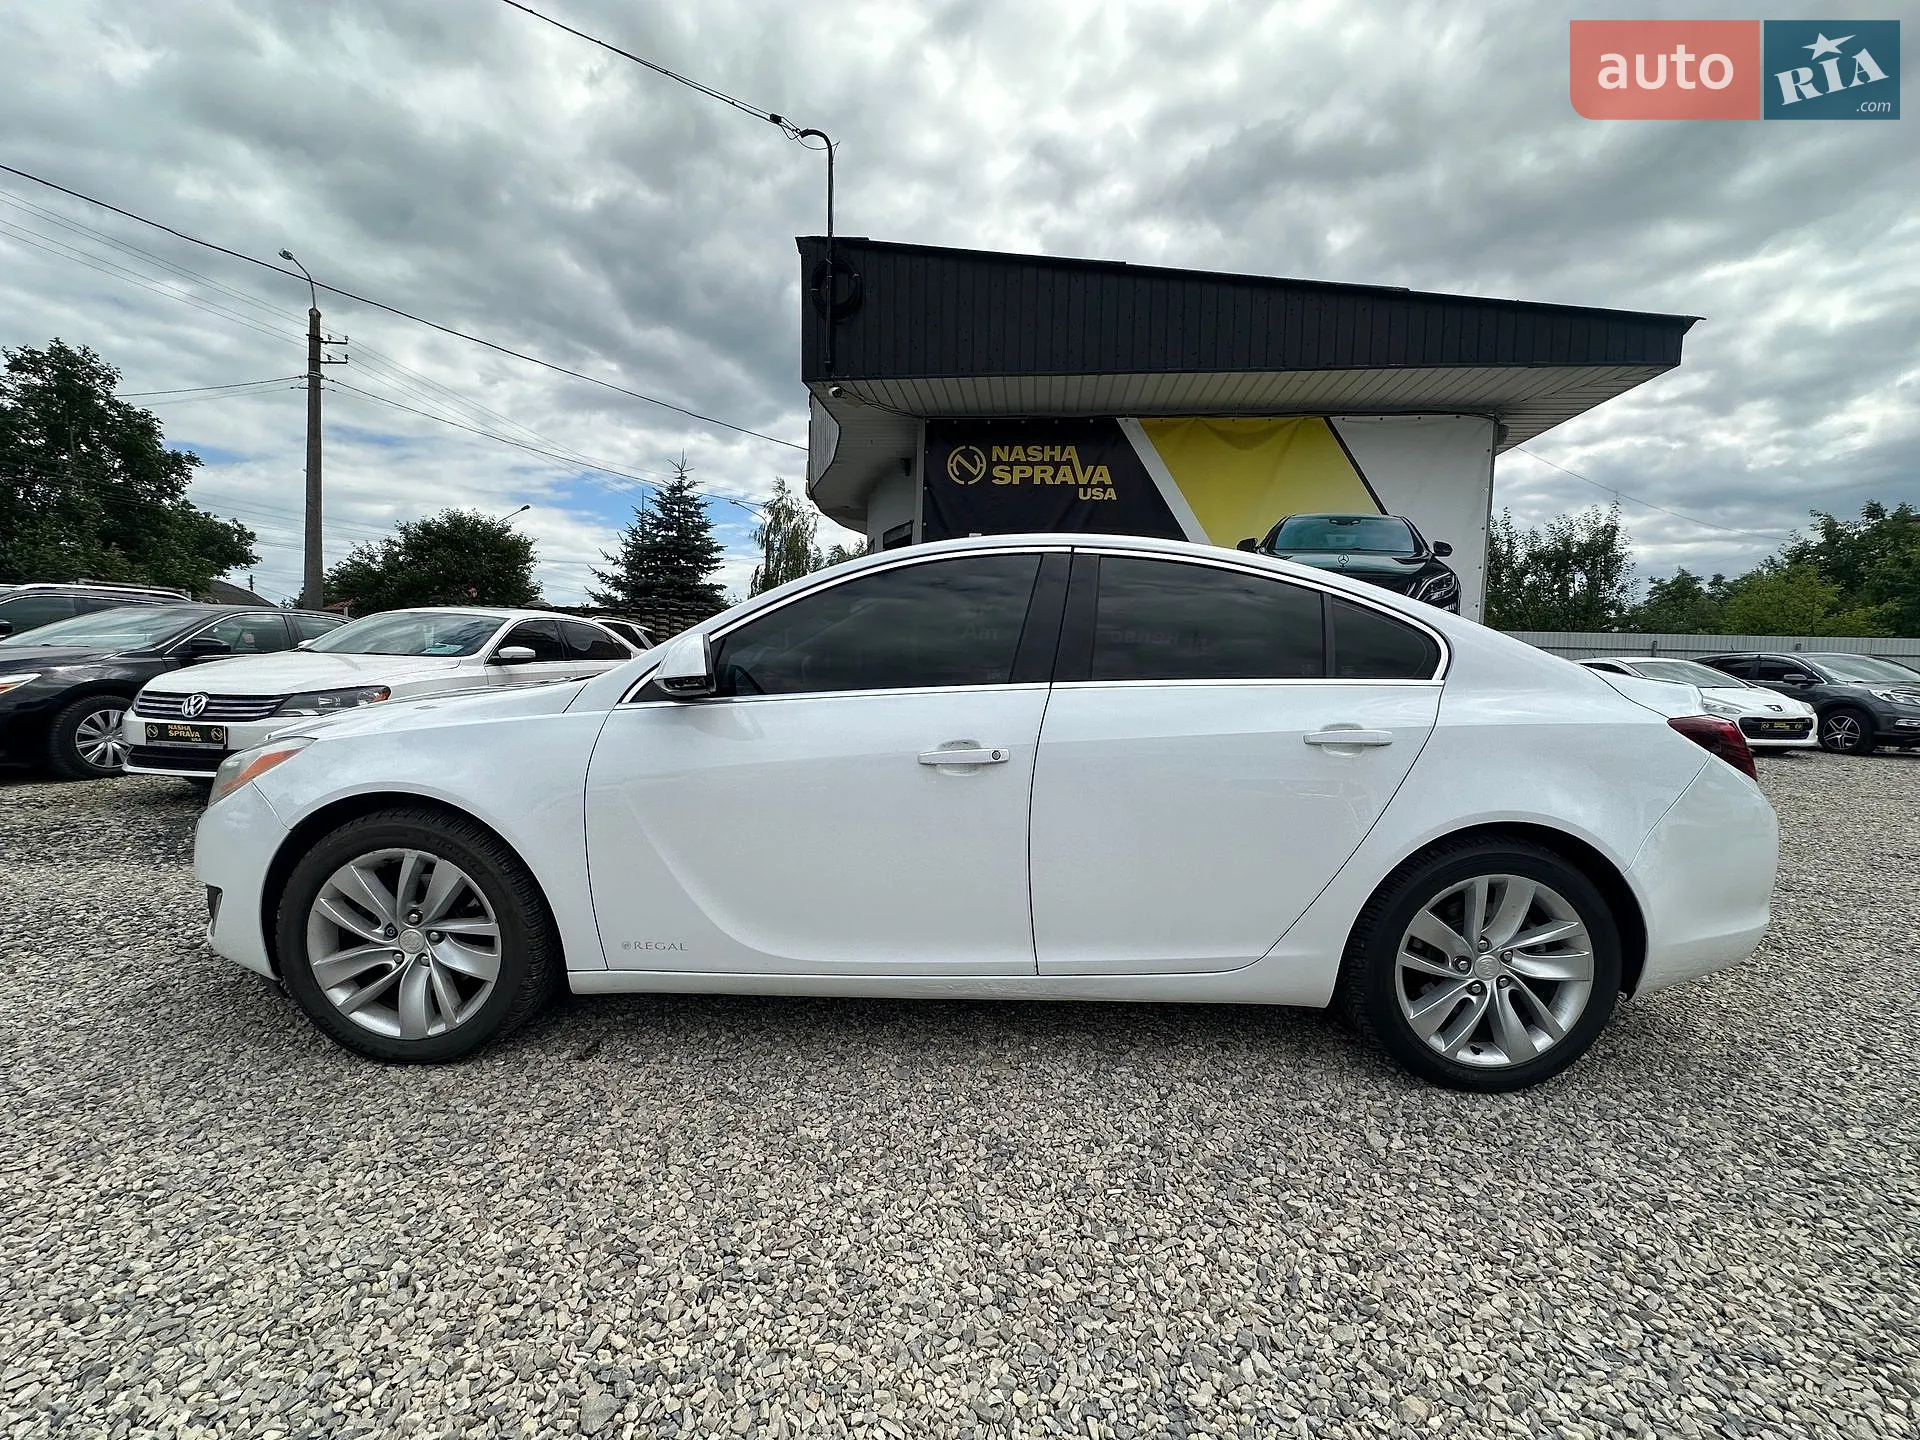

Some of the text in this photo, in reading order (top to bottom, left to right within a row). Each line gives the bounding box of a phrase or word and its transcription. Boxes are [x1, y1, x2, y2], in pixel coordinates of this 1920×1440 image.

[991, 445, 1077, 462] NASHA
[991, 465, 1113, 485] SPRAVA
[1078, 487, 1117, 501] USA
[168, 730, 201, 738] SPRAVA
[634, 941, 689, 951] REGAL
